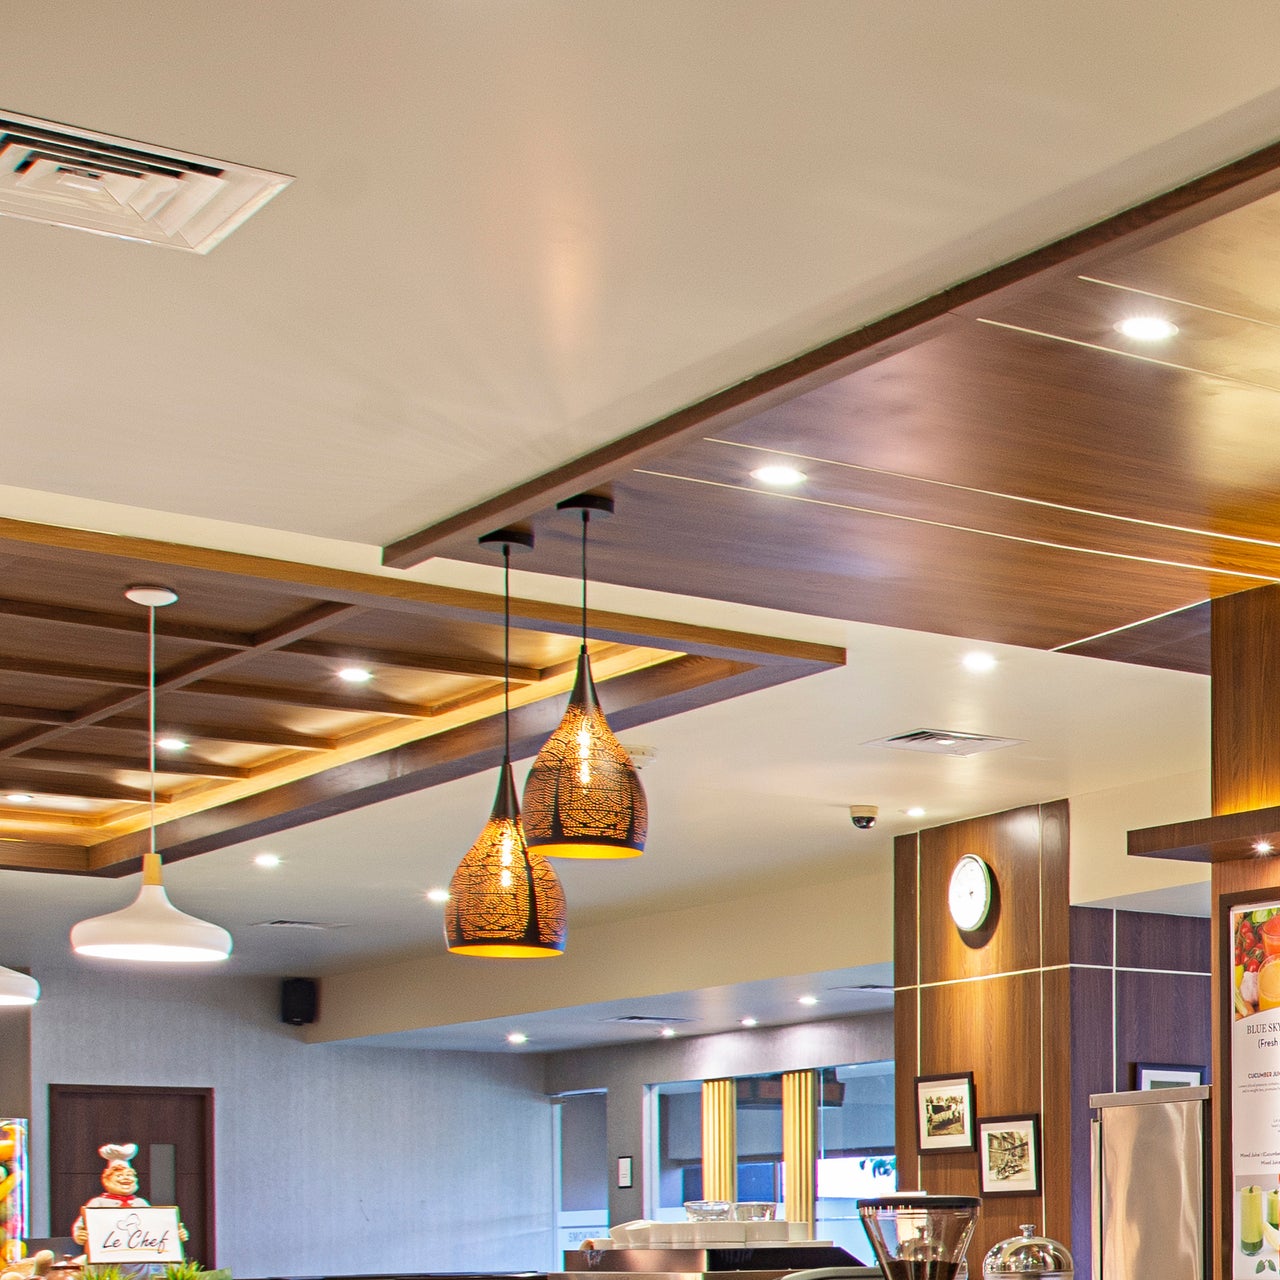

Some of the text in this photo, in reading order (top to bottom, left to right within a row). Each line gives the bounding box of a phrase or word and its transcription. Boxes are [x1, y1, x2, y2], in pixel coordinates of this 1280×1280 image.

[1247, 1023, 1267, 1035] BLUE
[1257, 1038, 1278, 1049] (Fresh
[1248, 1071, 1272, 1079] CUCUMBER
[102, 1229, 169, 1254] Le Chef
[568, 1231, 600, 1242] SMOKING
